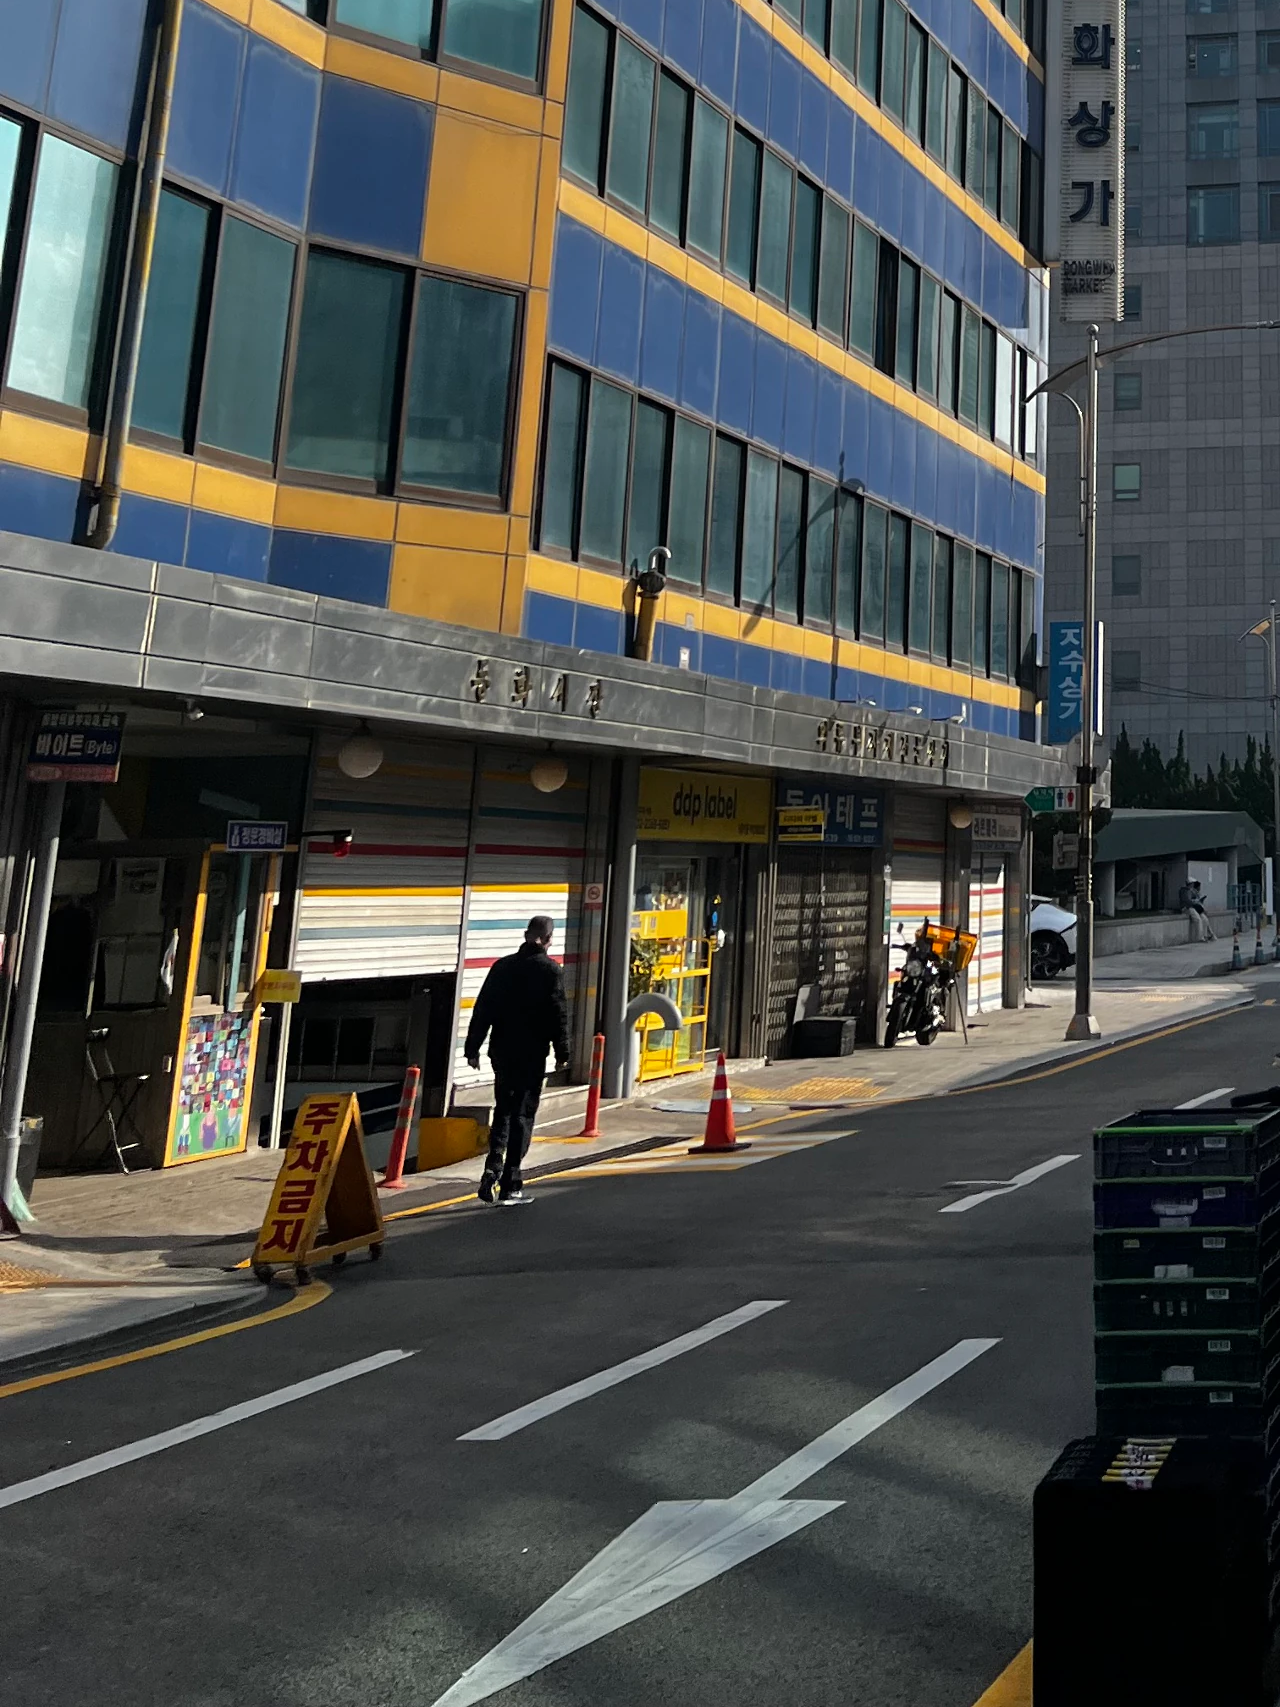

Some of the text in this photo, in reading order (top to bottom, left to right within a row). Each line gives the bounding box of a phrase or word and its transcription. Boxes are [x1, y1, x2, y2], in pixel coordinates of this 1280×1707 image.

[469, 655, 604, 720] 동화시장
[36, 732, 117, 758] 바이트(Byte)
[673, 783, 738, 826] ddp label
[262, 1101, 341, 1254] 주차금지
